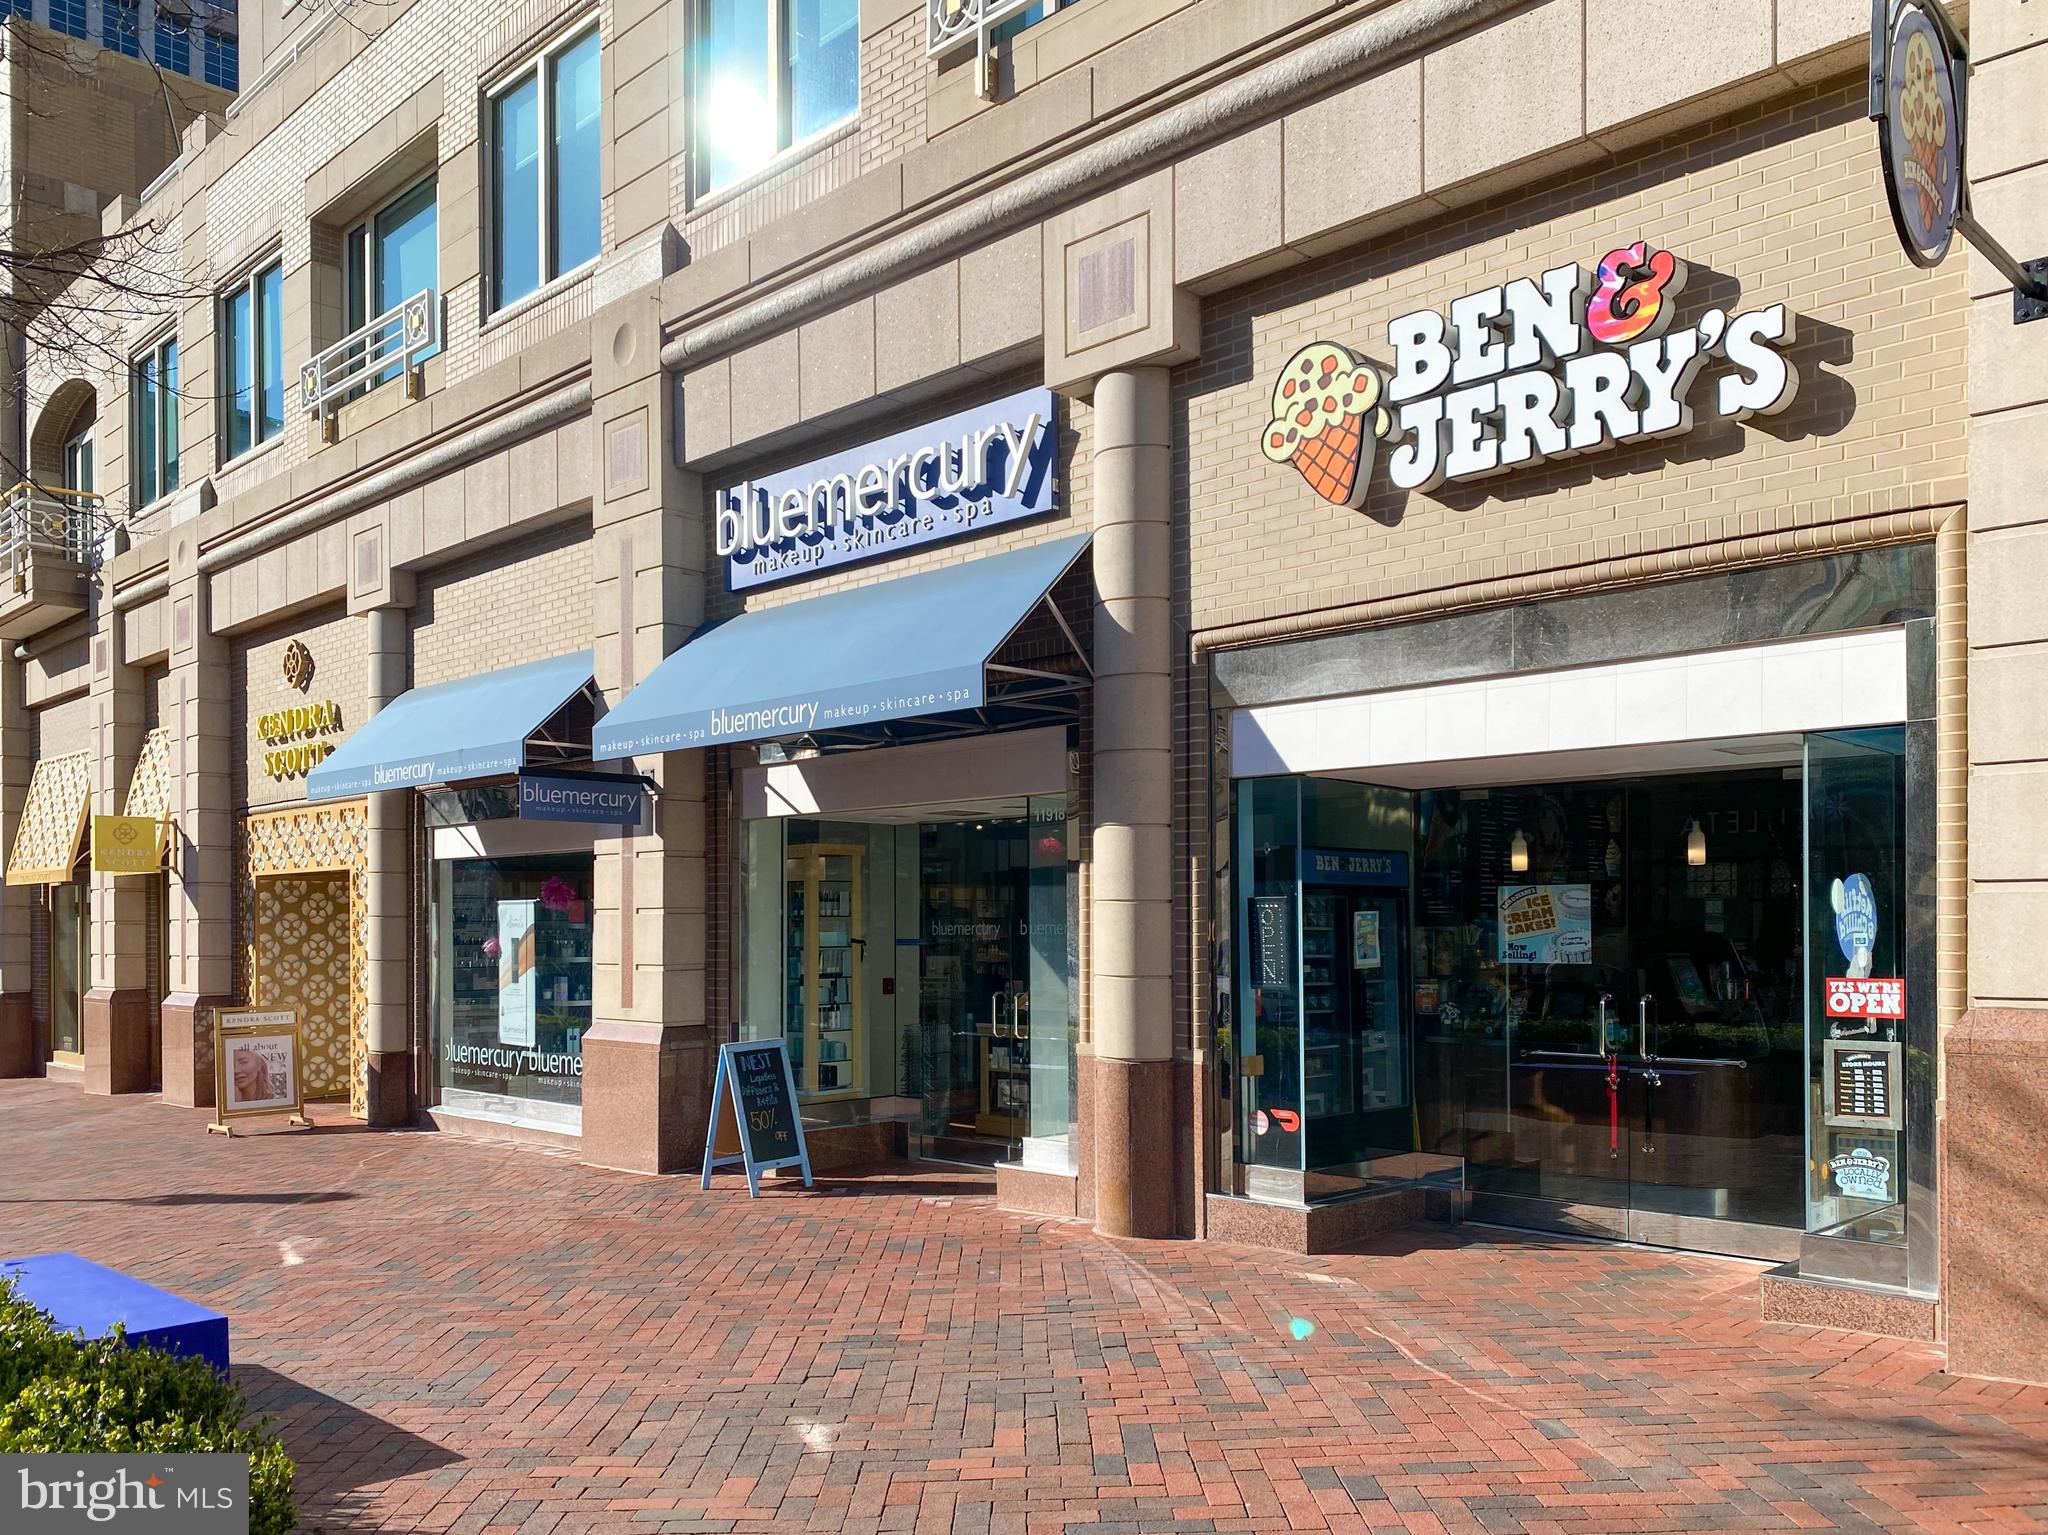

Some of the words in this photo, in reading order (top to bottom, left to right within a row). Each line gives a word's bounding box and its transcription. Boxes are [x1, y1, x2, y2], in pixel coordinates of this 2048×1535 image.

[1389, 262, 1581, 399] BEN
[1587, 241, 1677, 344] &
[1389, 304, 1792, 490] JERRY'S
[716, 413, 1042, 556] bluemercury
[753, 545, 825, 576] makeup
[844, 515, 935, 551] skincare
[953, 498, 994, 528] spa
[255, 700, 333, 741] KENDRA
[600, 740, 634, 753] makeup
[641, 733, 681, 747] skincare
[689, 729, 705, 741] spa
[711, 701, 819, 736] bluemercury
[824, 703, 870, 720] makeup
[880, 693, 935, 711] skincare
[947, 688, 970, 703] spa
[263, 742, 328, 777] SCOTT
[374, 761, 435, 786] bluemercury
[437, 765, 463, 776] makeup
[468, 760, 498, 772] skincare
[503, 758, 517, 768] spa
[523, 782, 638, 813] bluemercury
[1035, 807, 1066, 823] 11918
[1315, 855, 1340, 871] BEN
[1349, 857, 1392, 874] JERRY'S
[1526, 895, 1551, 909] ICE
[1503, 907, 1554, 925] CREAM
[932, 920, 1001, 938] bluemercury
[1507, 918, 1556, 936] CAKES!
[1262, 908, 1277, 980] OPEN
[1508, 943, 1528, 951] Now
[1502, 950, 1537, 962] Selling!
[1829, 981, 1855, 993] YES
[1856, 981, 1901, 994] WE'RE
[1829, 993, 1901, 1015] OPEN
[226, 1016, 260, 1024] KENDRA
[264, 1014, 290, 1022] SCOTT
[240, 1043, 250, 1052] all
[253, 1043, 278, 1051] about
[261, 1052, 288, 1061] NEW
[741, 1052, 772, 1072] NEST
[450, 1066, 471, 1076] makeup
[474, 1069, 499, 1079] skincare
[502, 1072, 512, 1081] spa
[750, 1108, 778, 1132] 50%
[774, 1130, 789, 1142] OFF
[1829, 1158, 1847, 1169] BEN
[1843, 1167, 1882, 1180] LOCALLY
